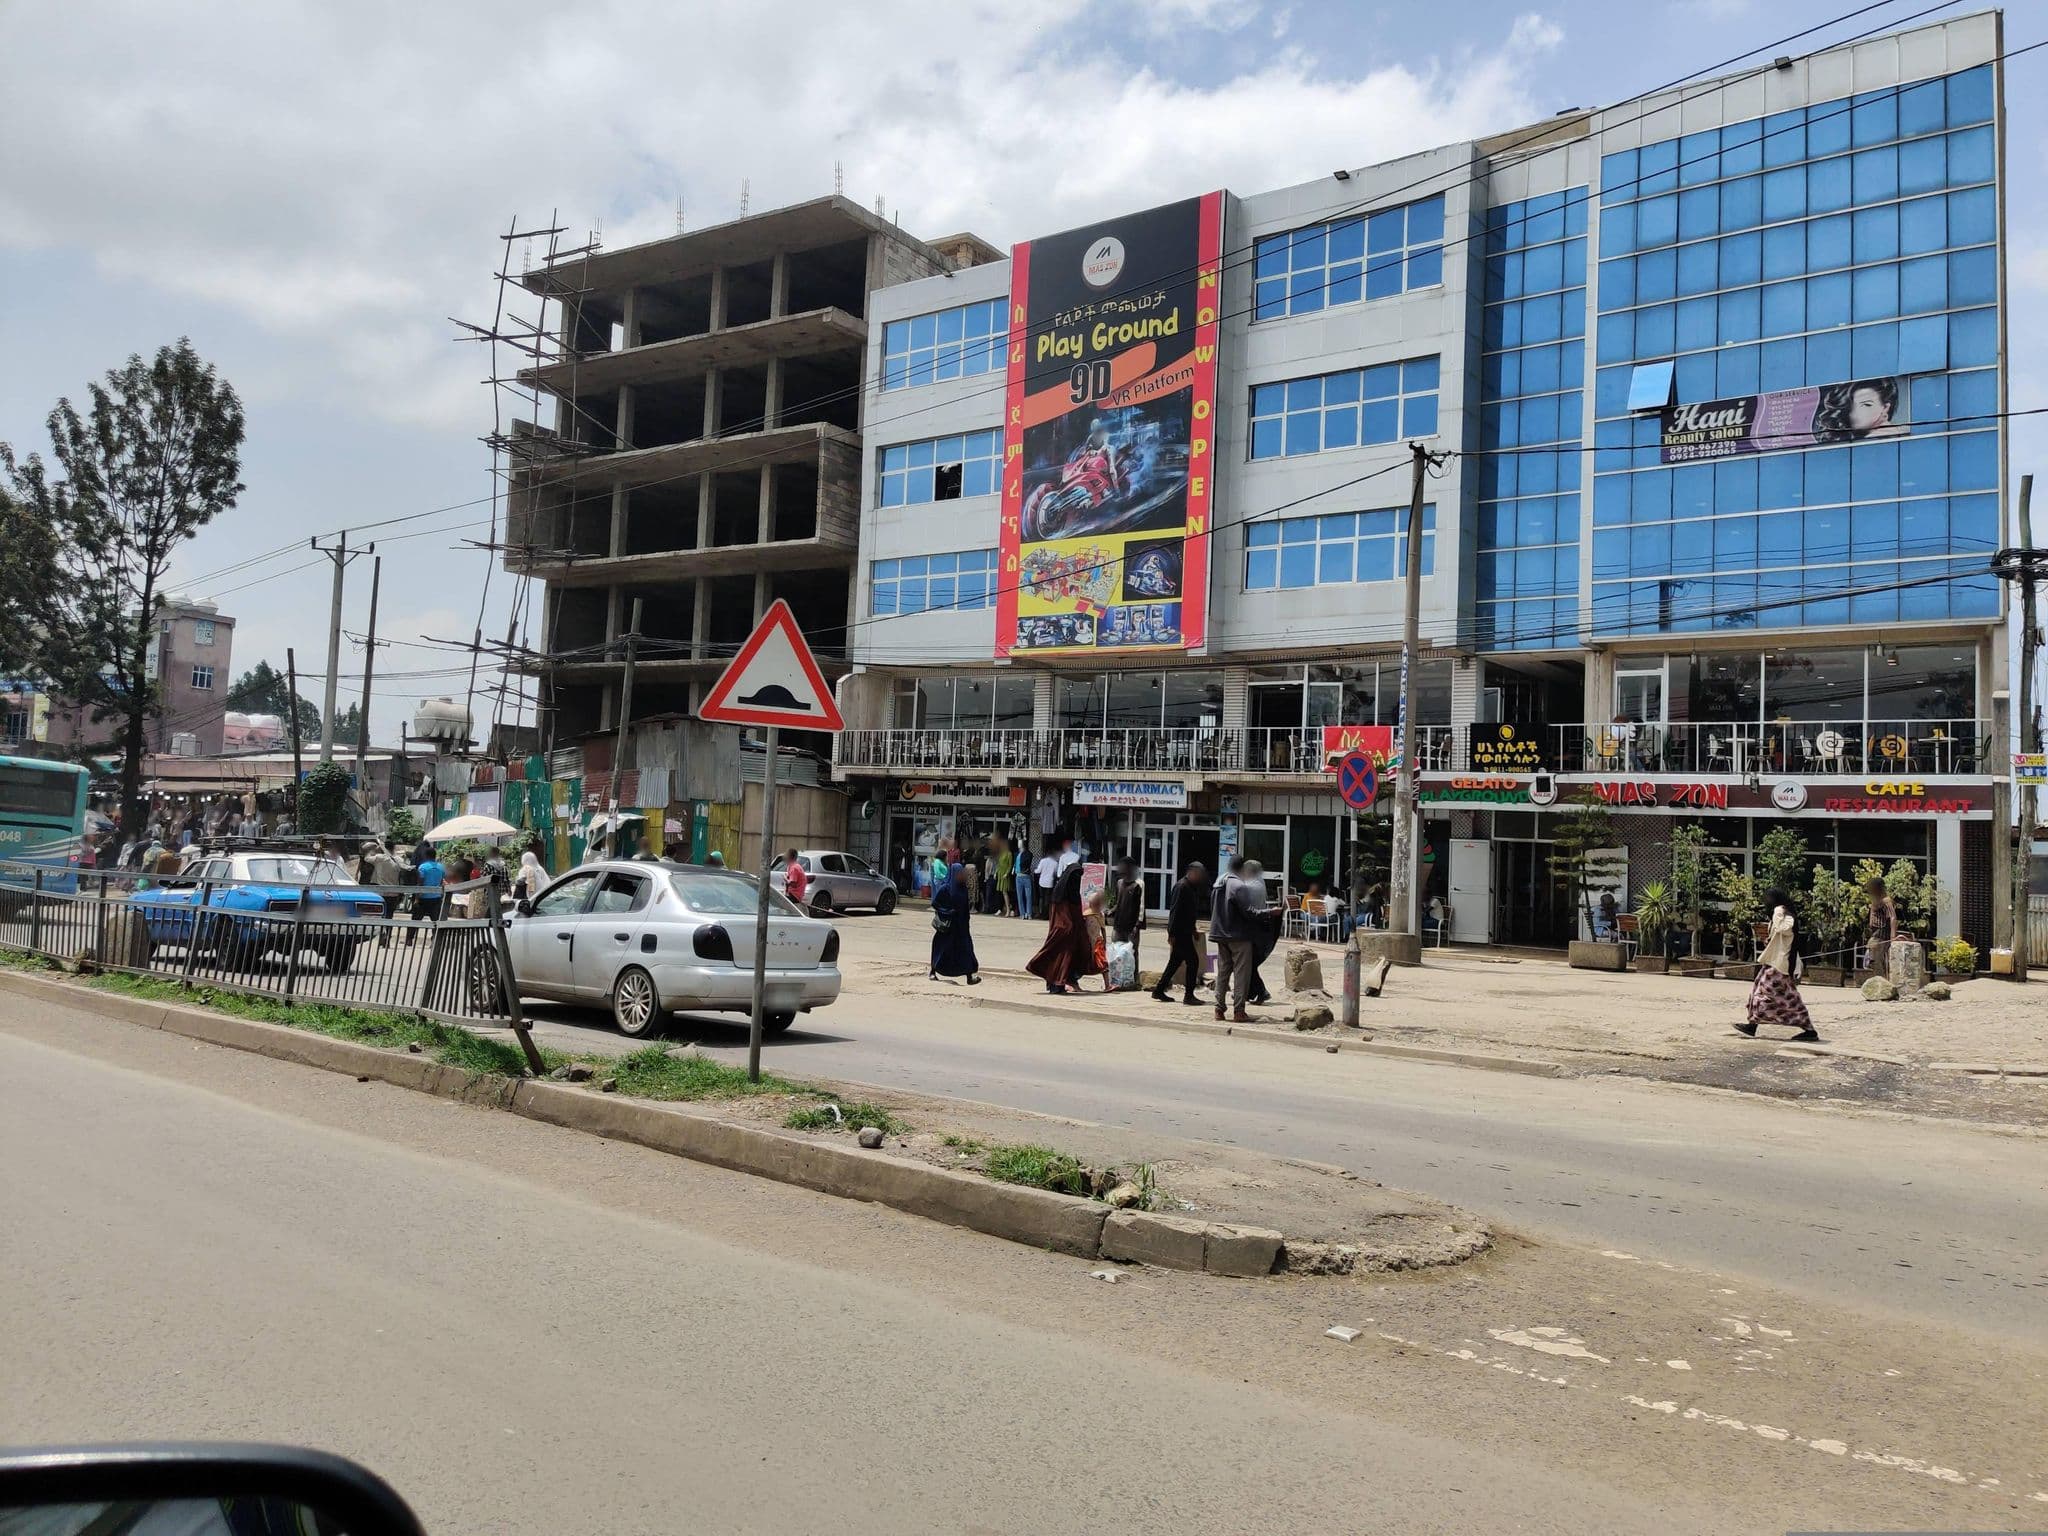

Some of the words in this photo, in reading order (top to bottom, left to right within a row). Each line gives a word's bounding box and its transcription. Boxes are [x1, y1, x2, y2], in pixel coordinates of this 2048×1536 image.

[1194, 269, 1217, 364] NOW
[1037, 332, 1083, 362] Play
[1092, 307, 1179, 352] Ground
[1069, 359, 1113, 405] 9D
[1111, 389, 1131, 406] VR
[1134, 366, 1195, 398] Platform
[1668, 400, 1747, 433] Hani
[1664, 431, 1705, 445] Beauty
[1710, 427, 1743, 440] salon
[1186, 399, 1211, 535] OPEN
[1497, 740, 1538, 753] የሴቶች
[1474, 753, 1511, 763] የውበት
[1513, 753, 1541, 764] ሳሎን
[1083, 782, 1118, 793] YISAK
[1118, 783, 1184, 795] PHARMACY
[1451, 777, 1518, 790] GELATO
[1865, 781, 1926, 796] CAFE
[1420, 788, 1530, 804] PLAYGROUND
[1593, 781, 1657, 807] MAS
[1668, 783, 1729, 809] ZON
[1825, 798, 1973, 814] RESTAURANT
